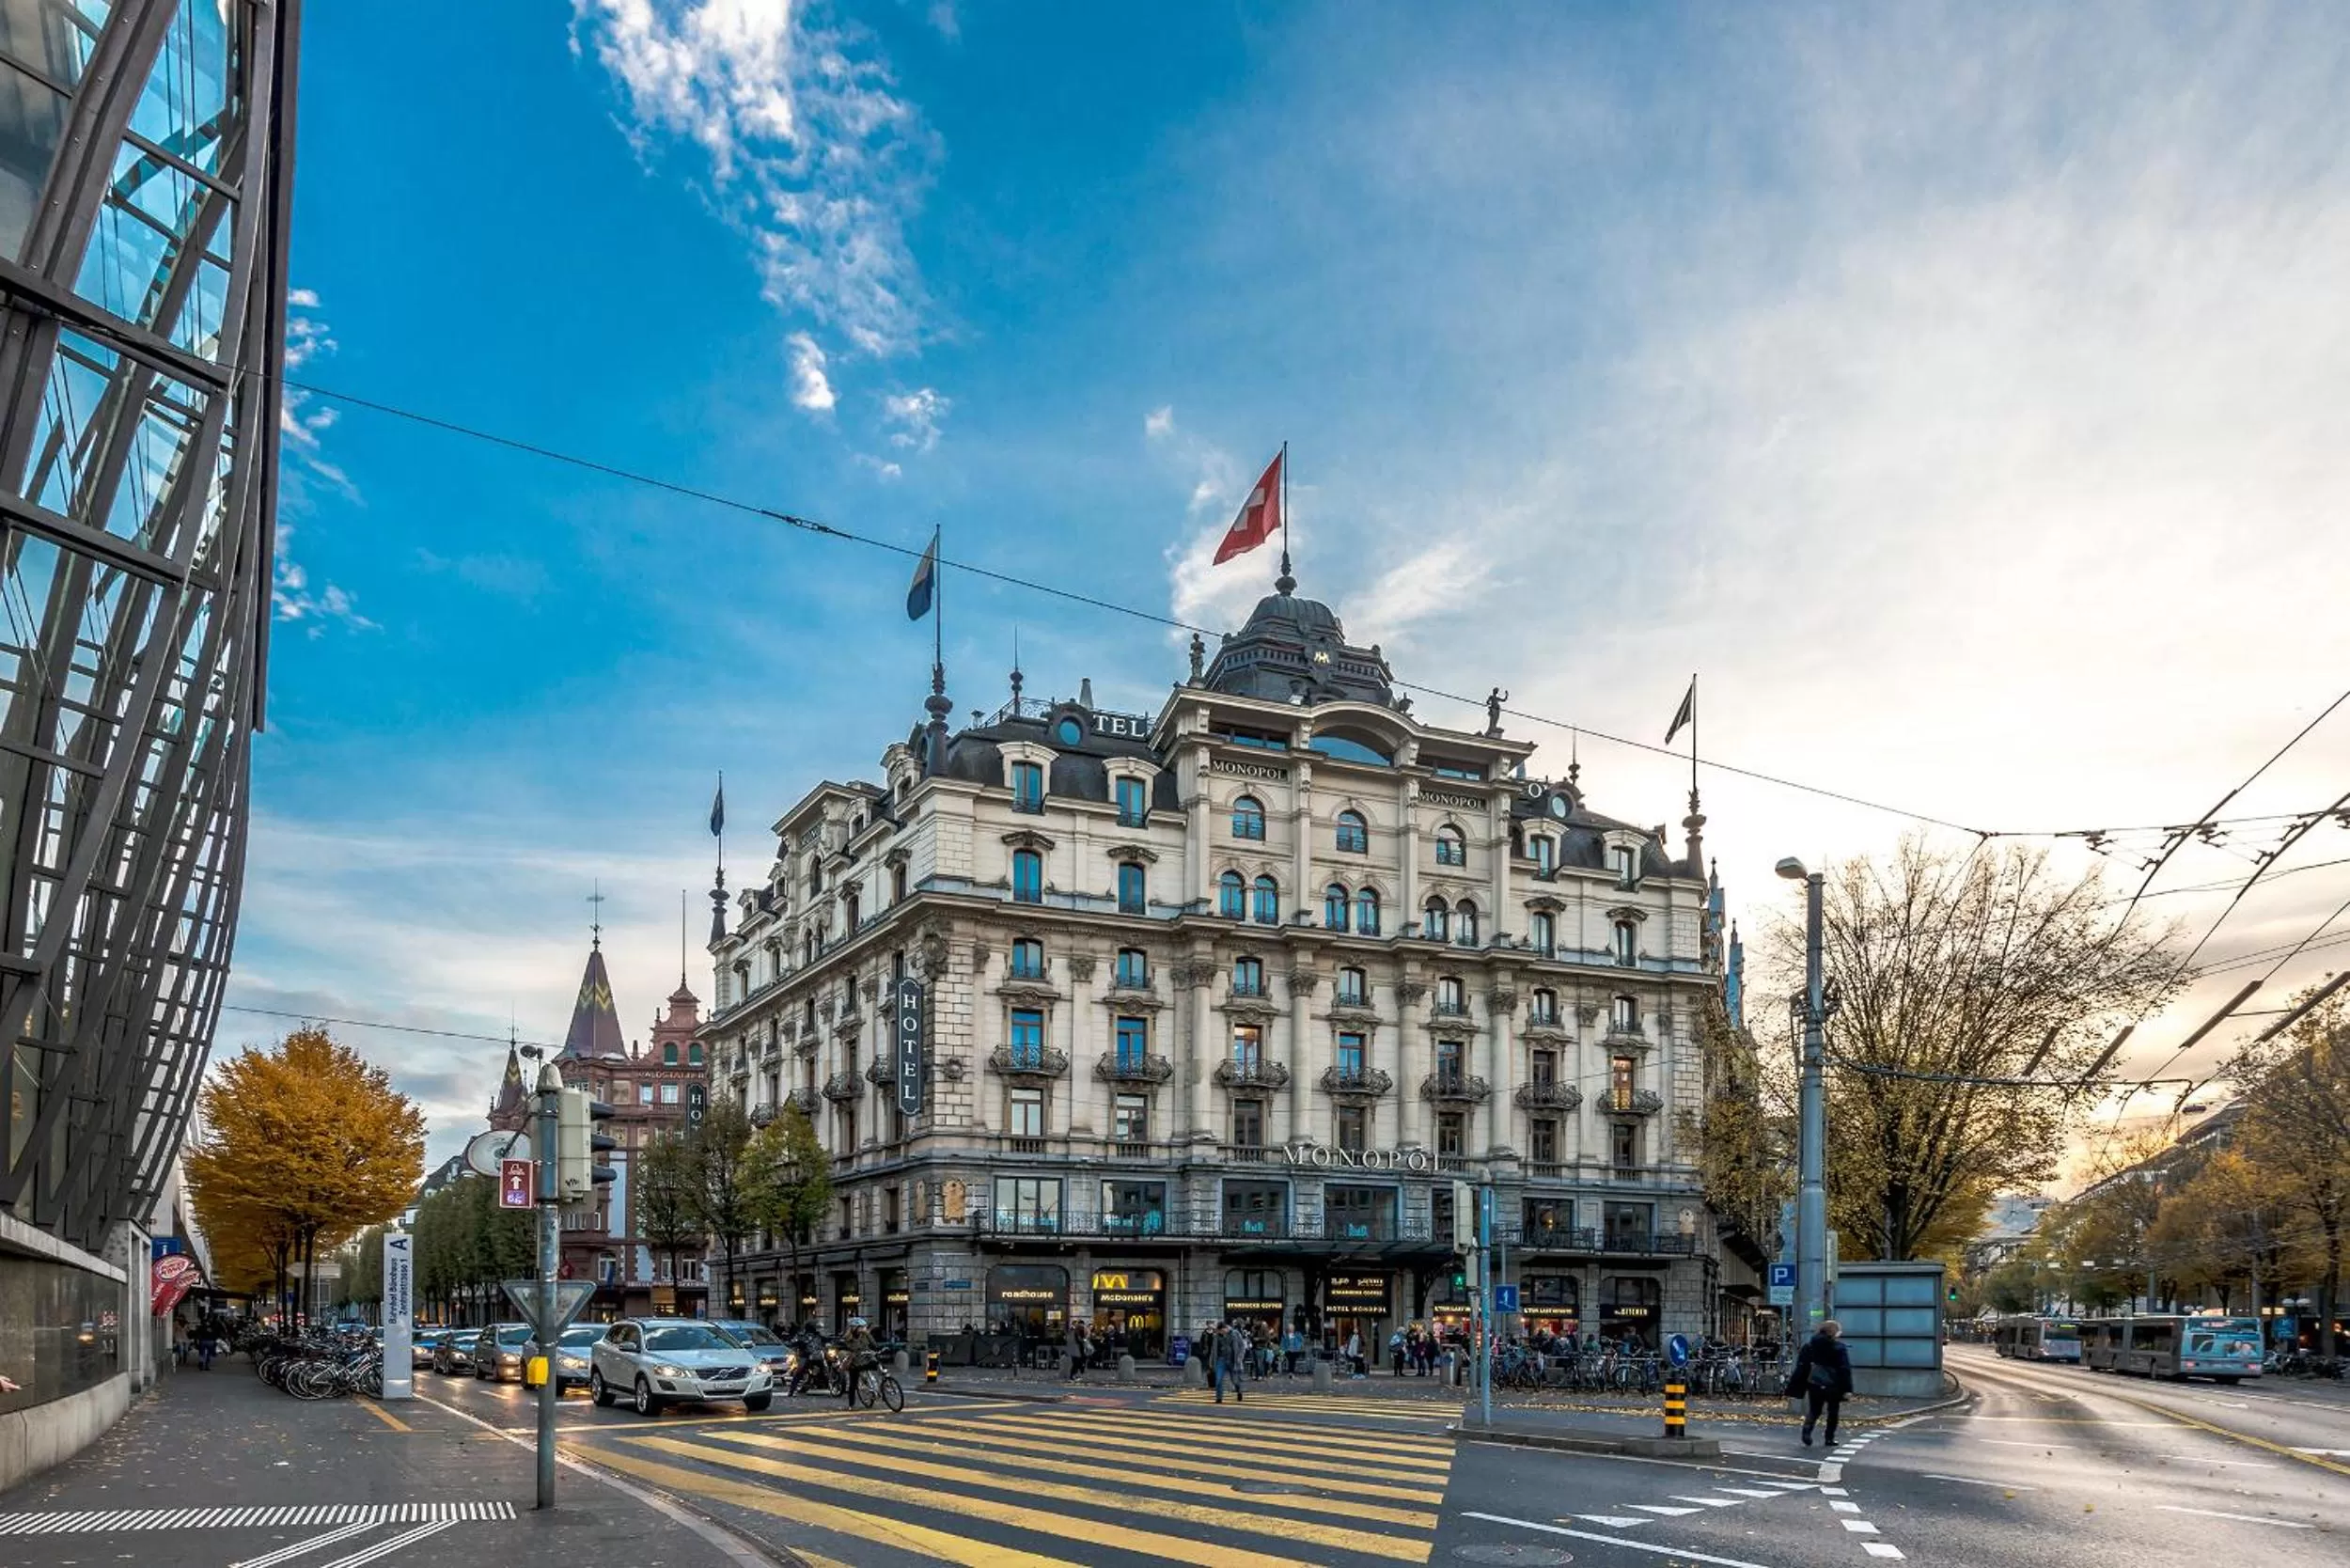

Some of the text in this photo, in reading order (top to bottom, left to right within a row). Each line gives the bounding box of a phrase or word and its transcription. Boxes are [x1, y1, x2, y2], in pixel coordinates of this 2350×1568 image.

[1213, 760, 1286, 780] MONOPOL
[1418, 792, 1485, 810] MONOPOL
[902, 994, 917, 1100] HOTEL
[1282, 1144, 1452, 1172] MONOPOL
[389, 1238, 408, 1251] A
[1774, 1267, 1789, 1284] P
[1001, 1290, 1055, 1299] roadhouse
[1100, 1294, 1154, 1303] McDonald's
